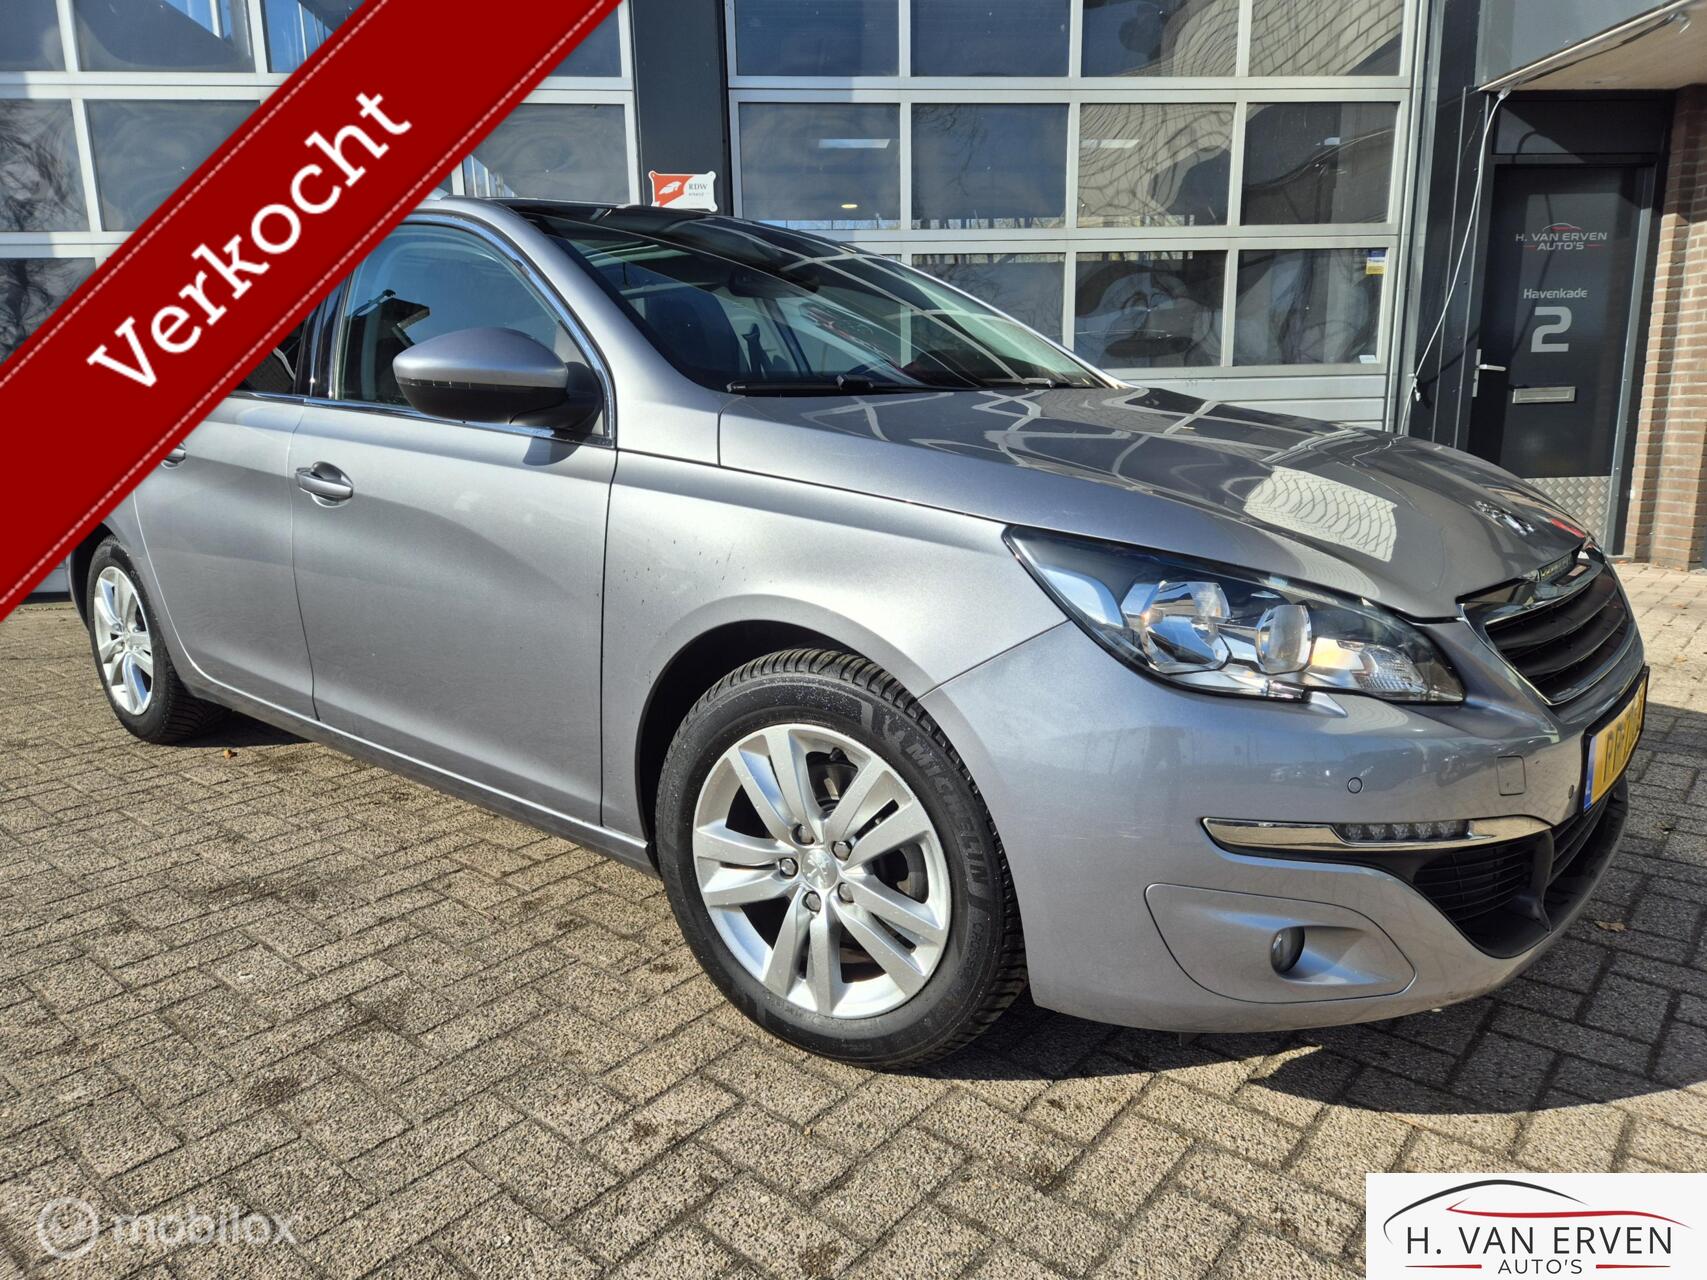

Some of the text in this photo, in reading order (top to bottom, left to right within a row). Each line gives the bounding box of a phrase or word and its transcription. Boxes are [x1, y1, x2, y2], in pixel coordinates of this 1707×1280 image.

[1515, 232, 1608, 242] H. VAN ERVEN
[1537, 241, 1585, 251] AUTO'S
[1523, 287, 1588, 299] Havenkade
[1530, 306, 1572, 353] 2
